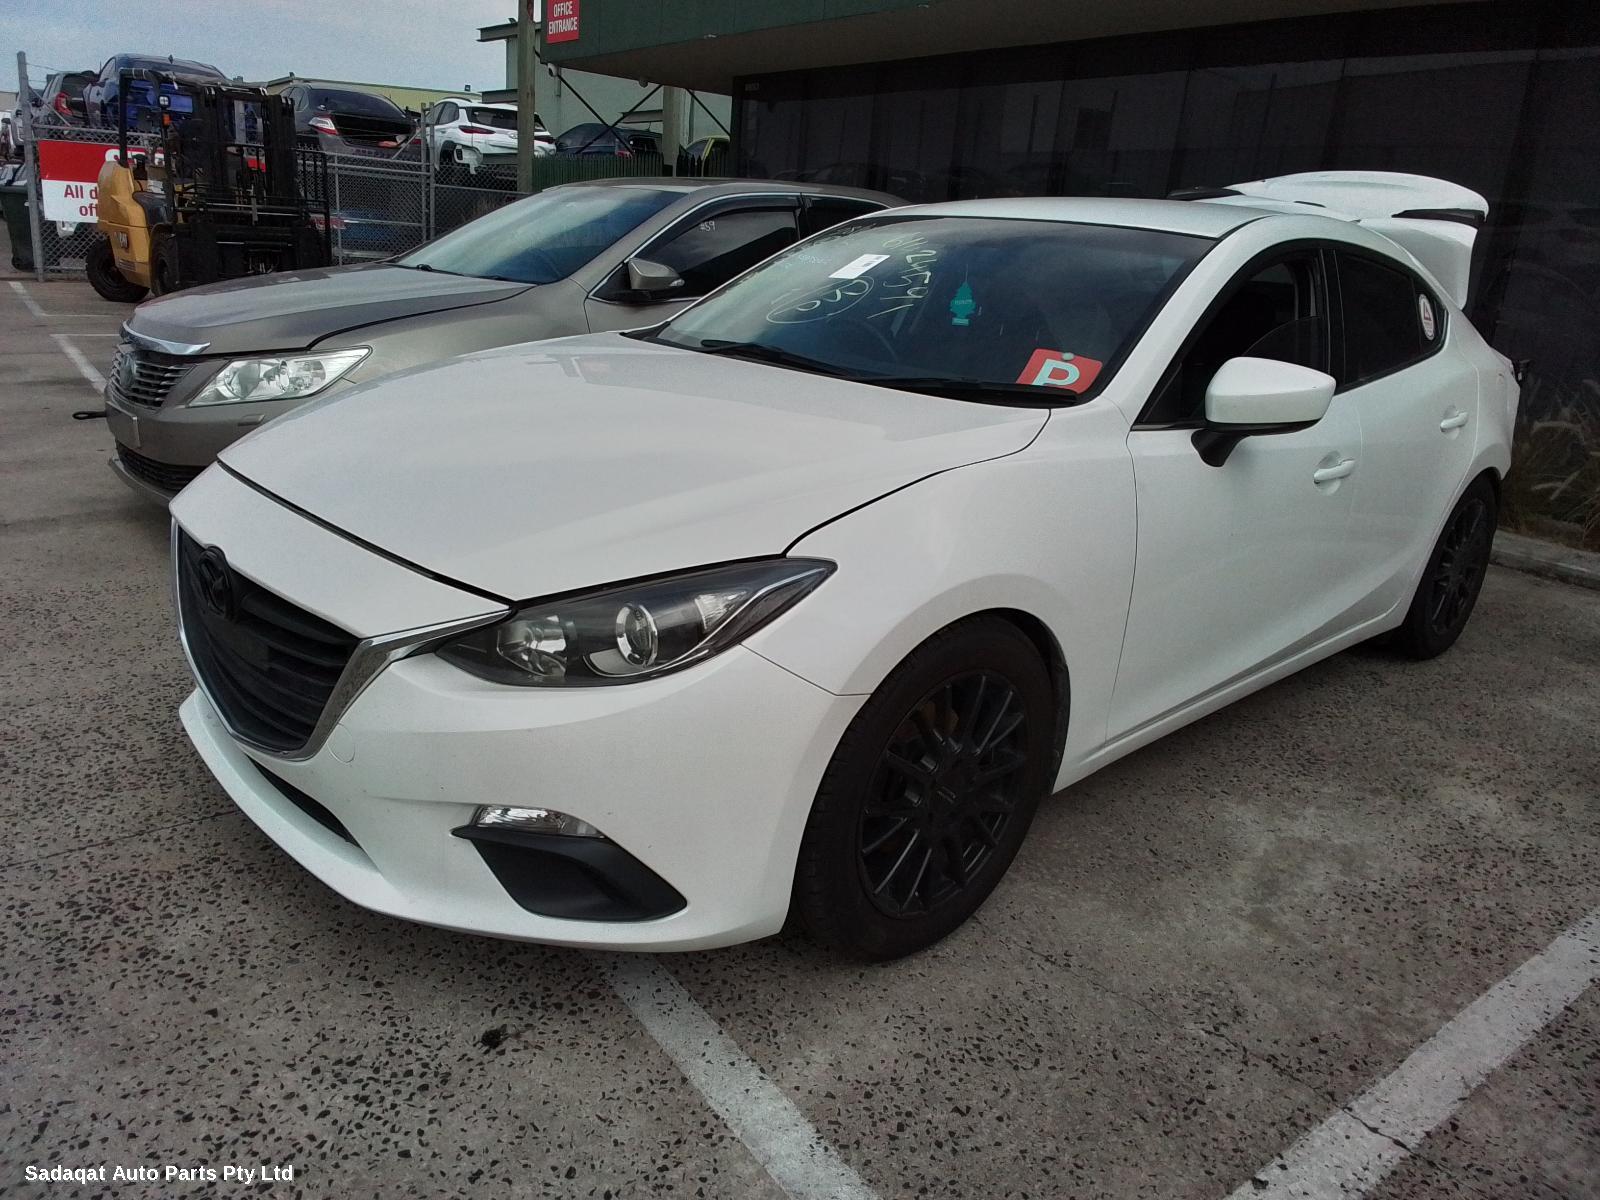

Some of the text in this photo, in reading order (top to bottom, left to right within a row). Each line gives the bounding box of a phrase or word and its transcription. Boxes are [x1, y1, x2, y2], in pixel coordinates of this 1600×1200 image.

[554, 1, 573, 17] OFFICE
[549, 17, 578, 35] ENTRANCE
[64, 185, 84, 199] All
[1031, 358, 1080, 386] P
